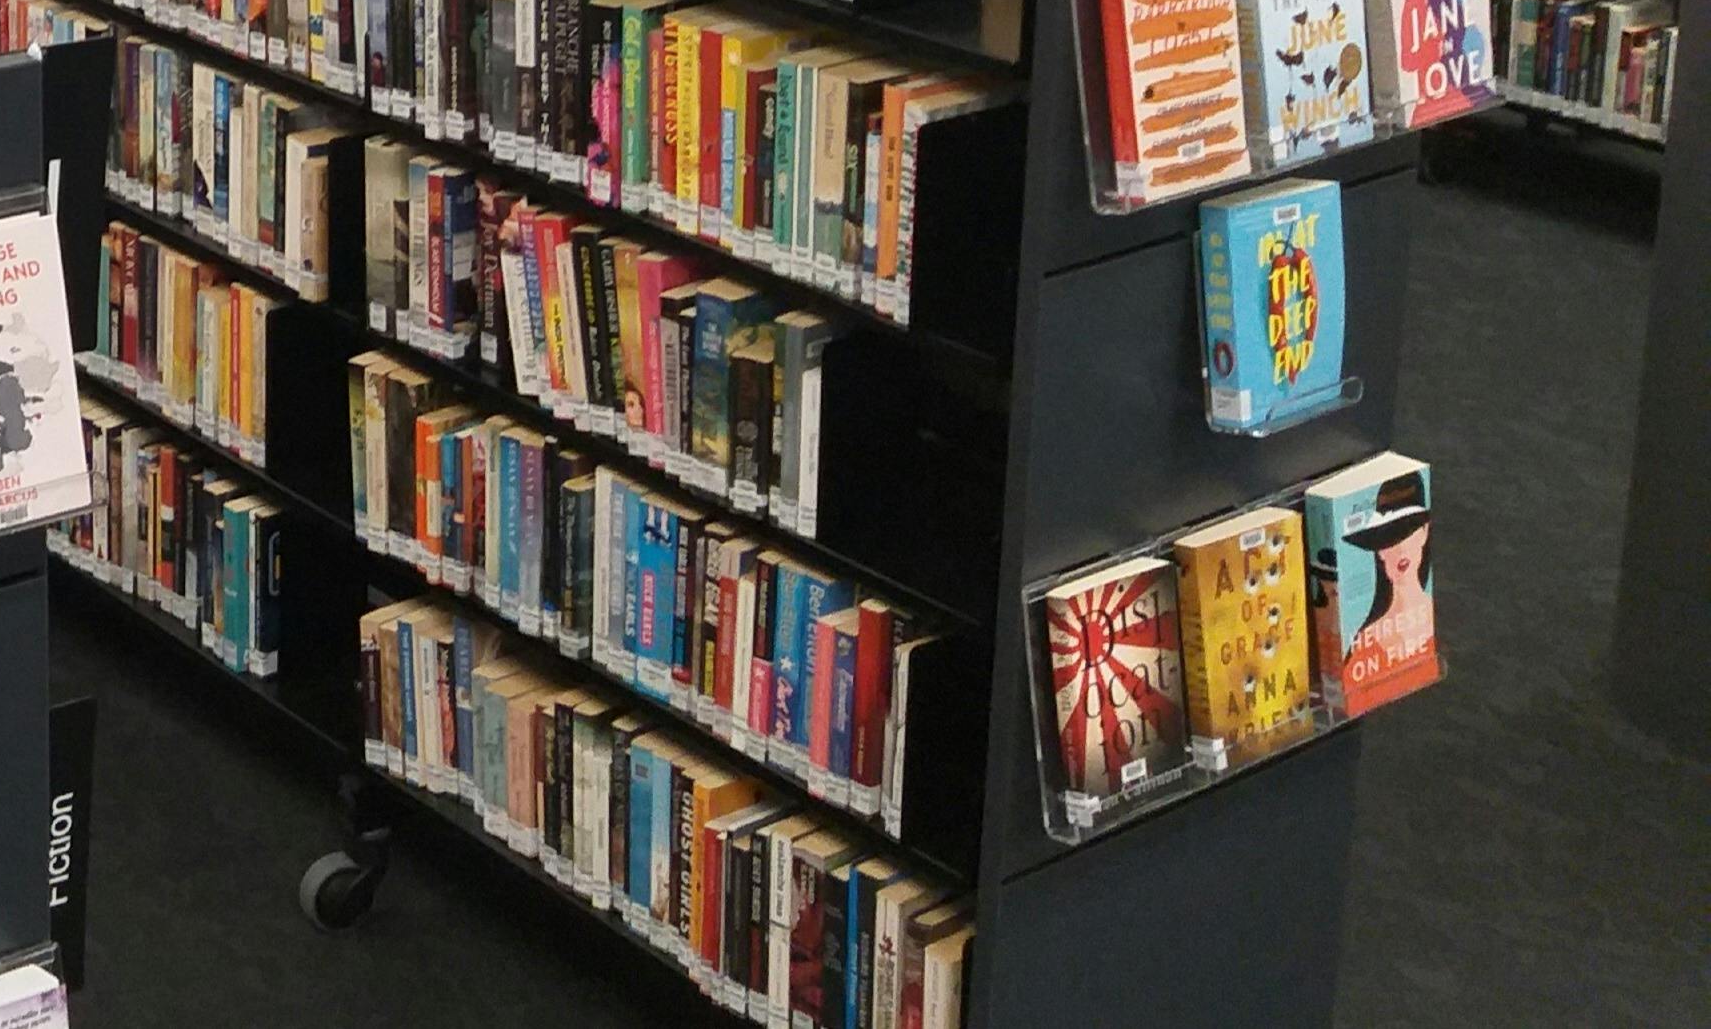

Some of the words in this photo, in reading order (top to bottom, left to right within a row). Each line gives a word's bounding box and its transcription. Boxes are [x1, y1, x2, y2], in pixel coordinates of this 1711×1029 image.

[1286, 15, 1348, 55] JUNE
[1411, 49, 1481, 106] LOVE
[1280, 90, 1362, 132] WINCH
[1292, 213, 1321, 249] AT
[1, 258, 41, 283] AND
[1268, 254, 1312, 304] THE
[1268, 296, 1317, 348] DEEP
[1272, 340, 1315, 386] END
[1241, 597, 1268, 624] OF
[1349, 604, 1432, 655] HEIRESS
[1219, 617, 1295, 666] GRACE
[1350, 657, 1381, 683] ON
[1386, 640, 1429, 666] FIRE
[1227, 667, 1297, 717] ANNA
[49, 791, 74, 908] Fiction
[680, 791, 694, 862] GHOST
